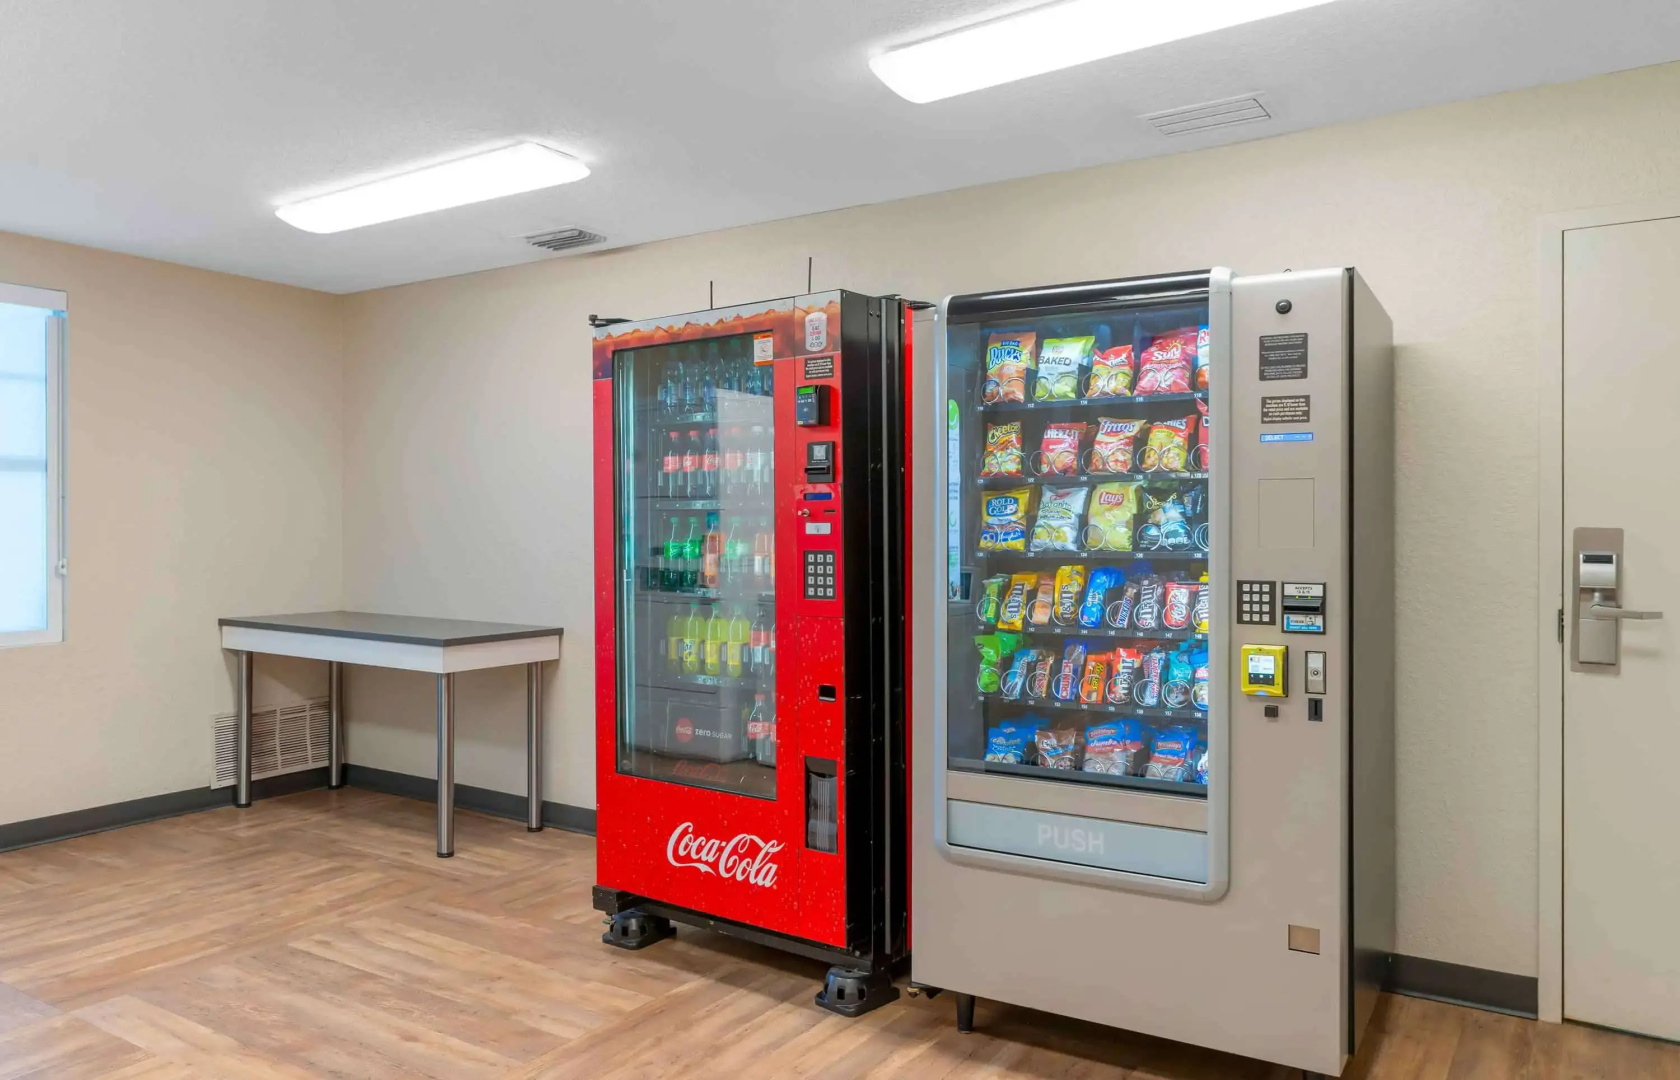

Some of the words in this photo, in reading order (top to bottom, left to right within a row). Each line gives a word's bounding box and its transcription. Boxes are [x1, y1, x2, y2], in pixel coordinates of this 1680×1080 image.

[1038, 355, 1072, 366] BAKED
[992, 498, 1014, 506] ROLD
[1061, 660, 1073, 699] CRUNCH
[695, 728, 711, 736] zero
[1038, 824, 1104, 855] PUSH
[666, 822, 785, 888] Coca-Cola
